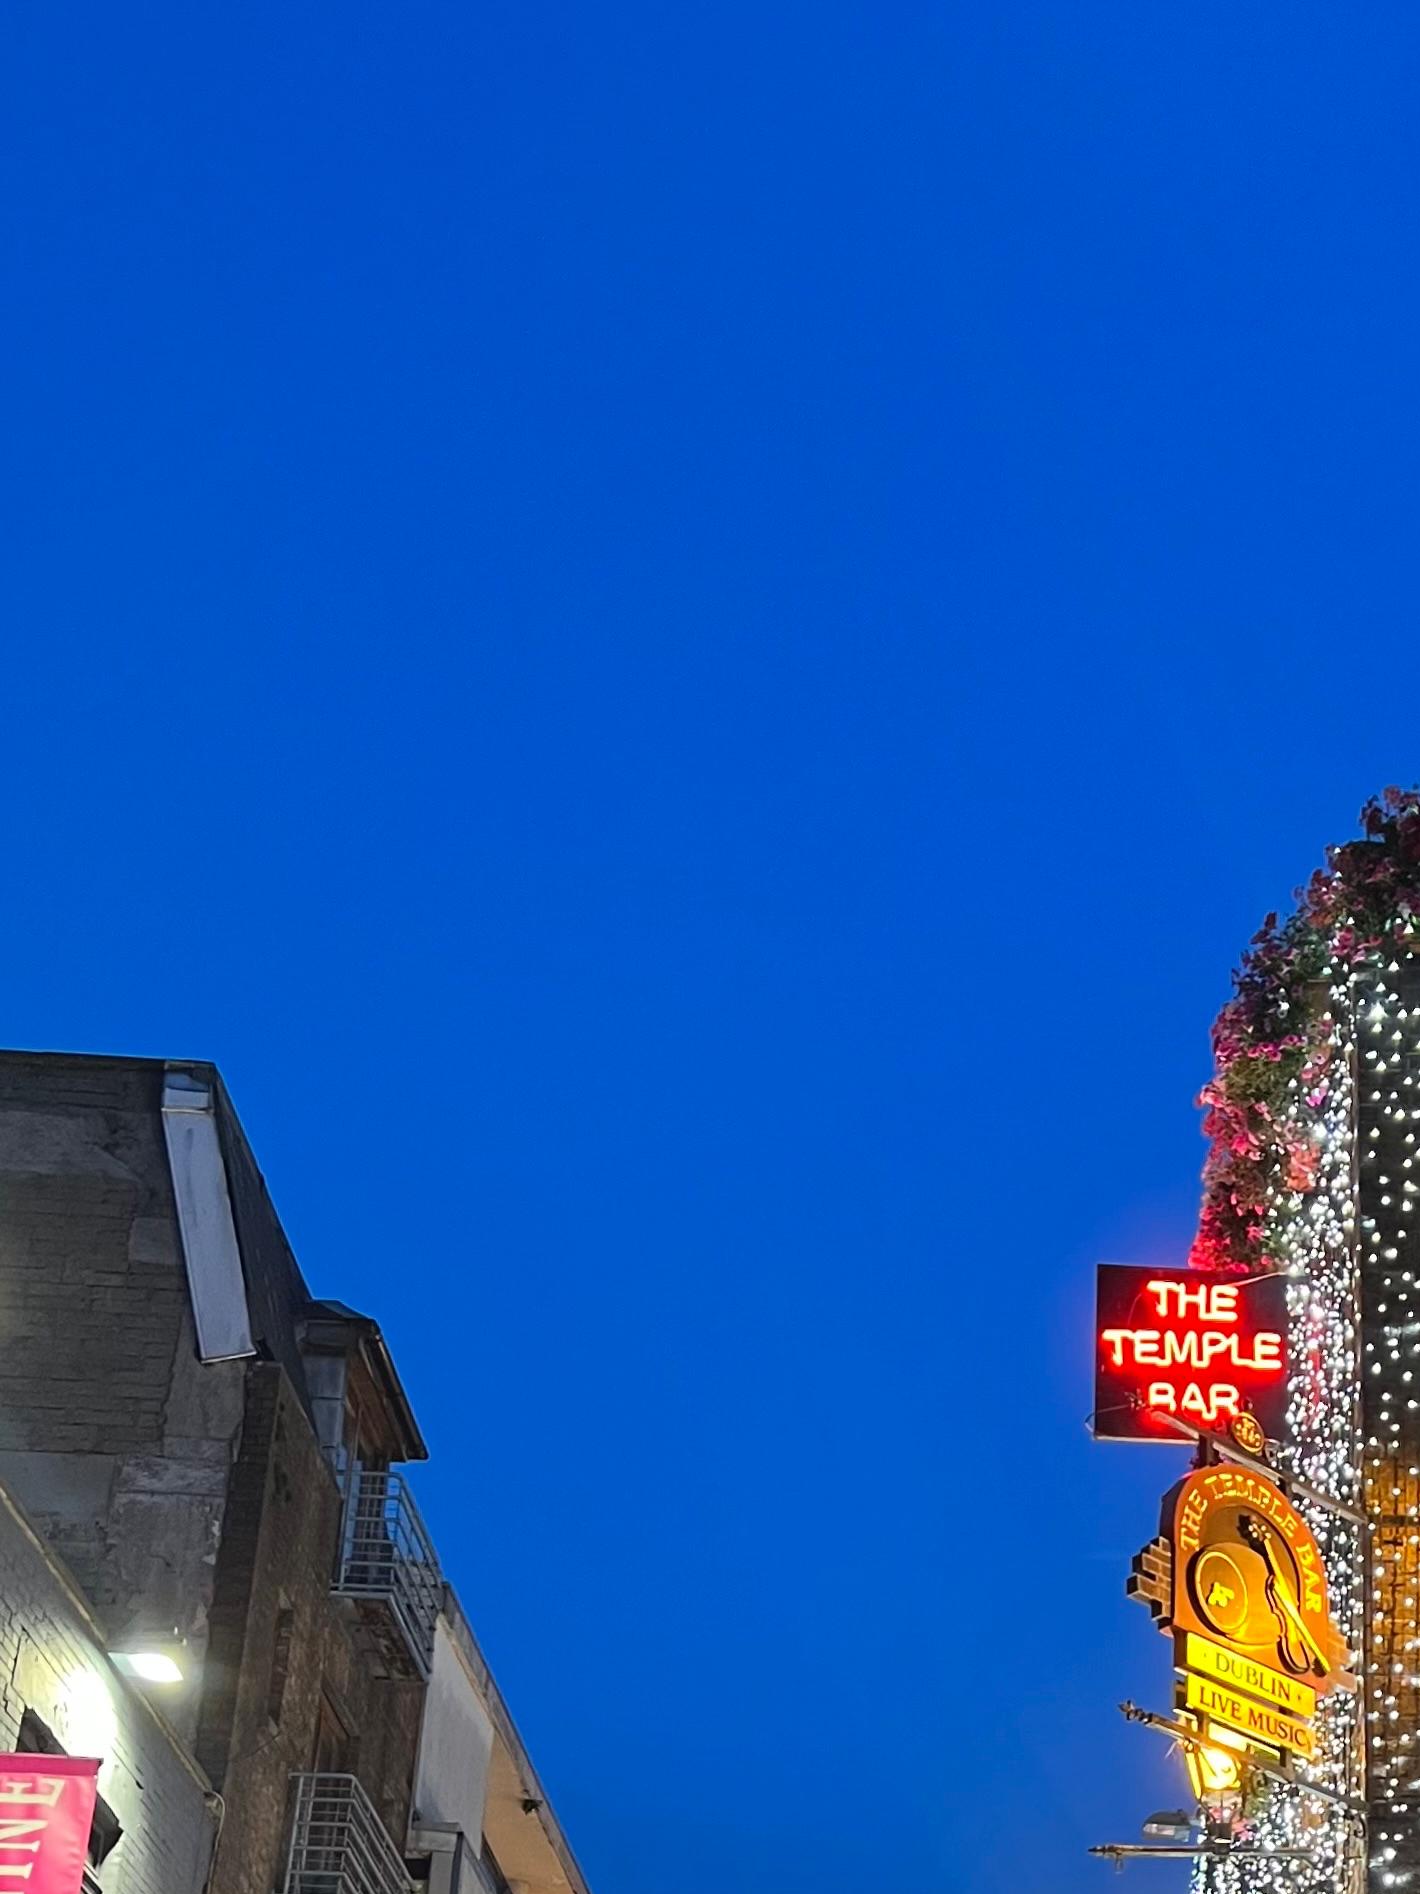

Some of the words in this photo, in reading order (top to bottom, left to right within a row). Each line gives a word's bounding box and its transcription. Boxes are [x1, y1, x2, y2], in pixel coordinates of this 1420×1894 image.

[1146, 1280, 1239, 1322] THE
[1103, 1328, 1283, 1371] TEMPLE
[1147, 1383, 1240, 1420] BAR
[1180, 1486, 1209, 1552] THE
[1203, 1473, 1300, 1541] TEMPLE
[1296, 1541, 1323, 1615] BAR
[1215, 1651, 1292, 1702] DUBLIN
[1199, 1685, 1242, 1721] LIVE
[1248, 1705, 1309, 1749] MUSIC
